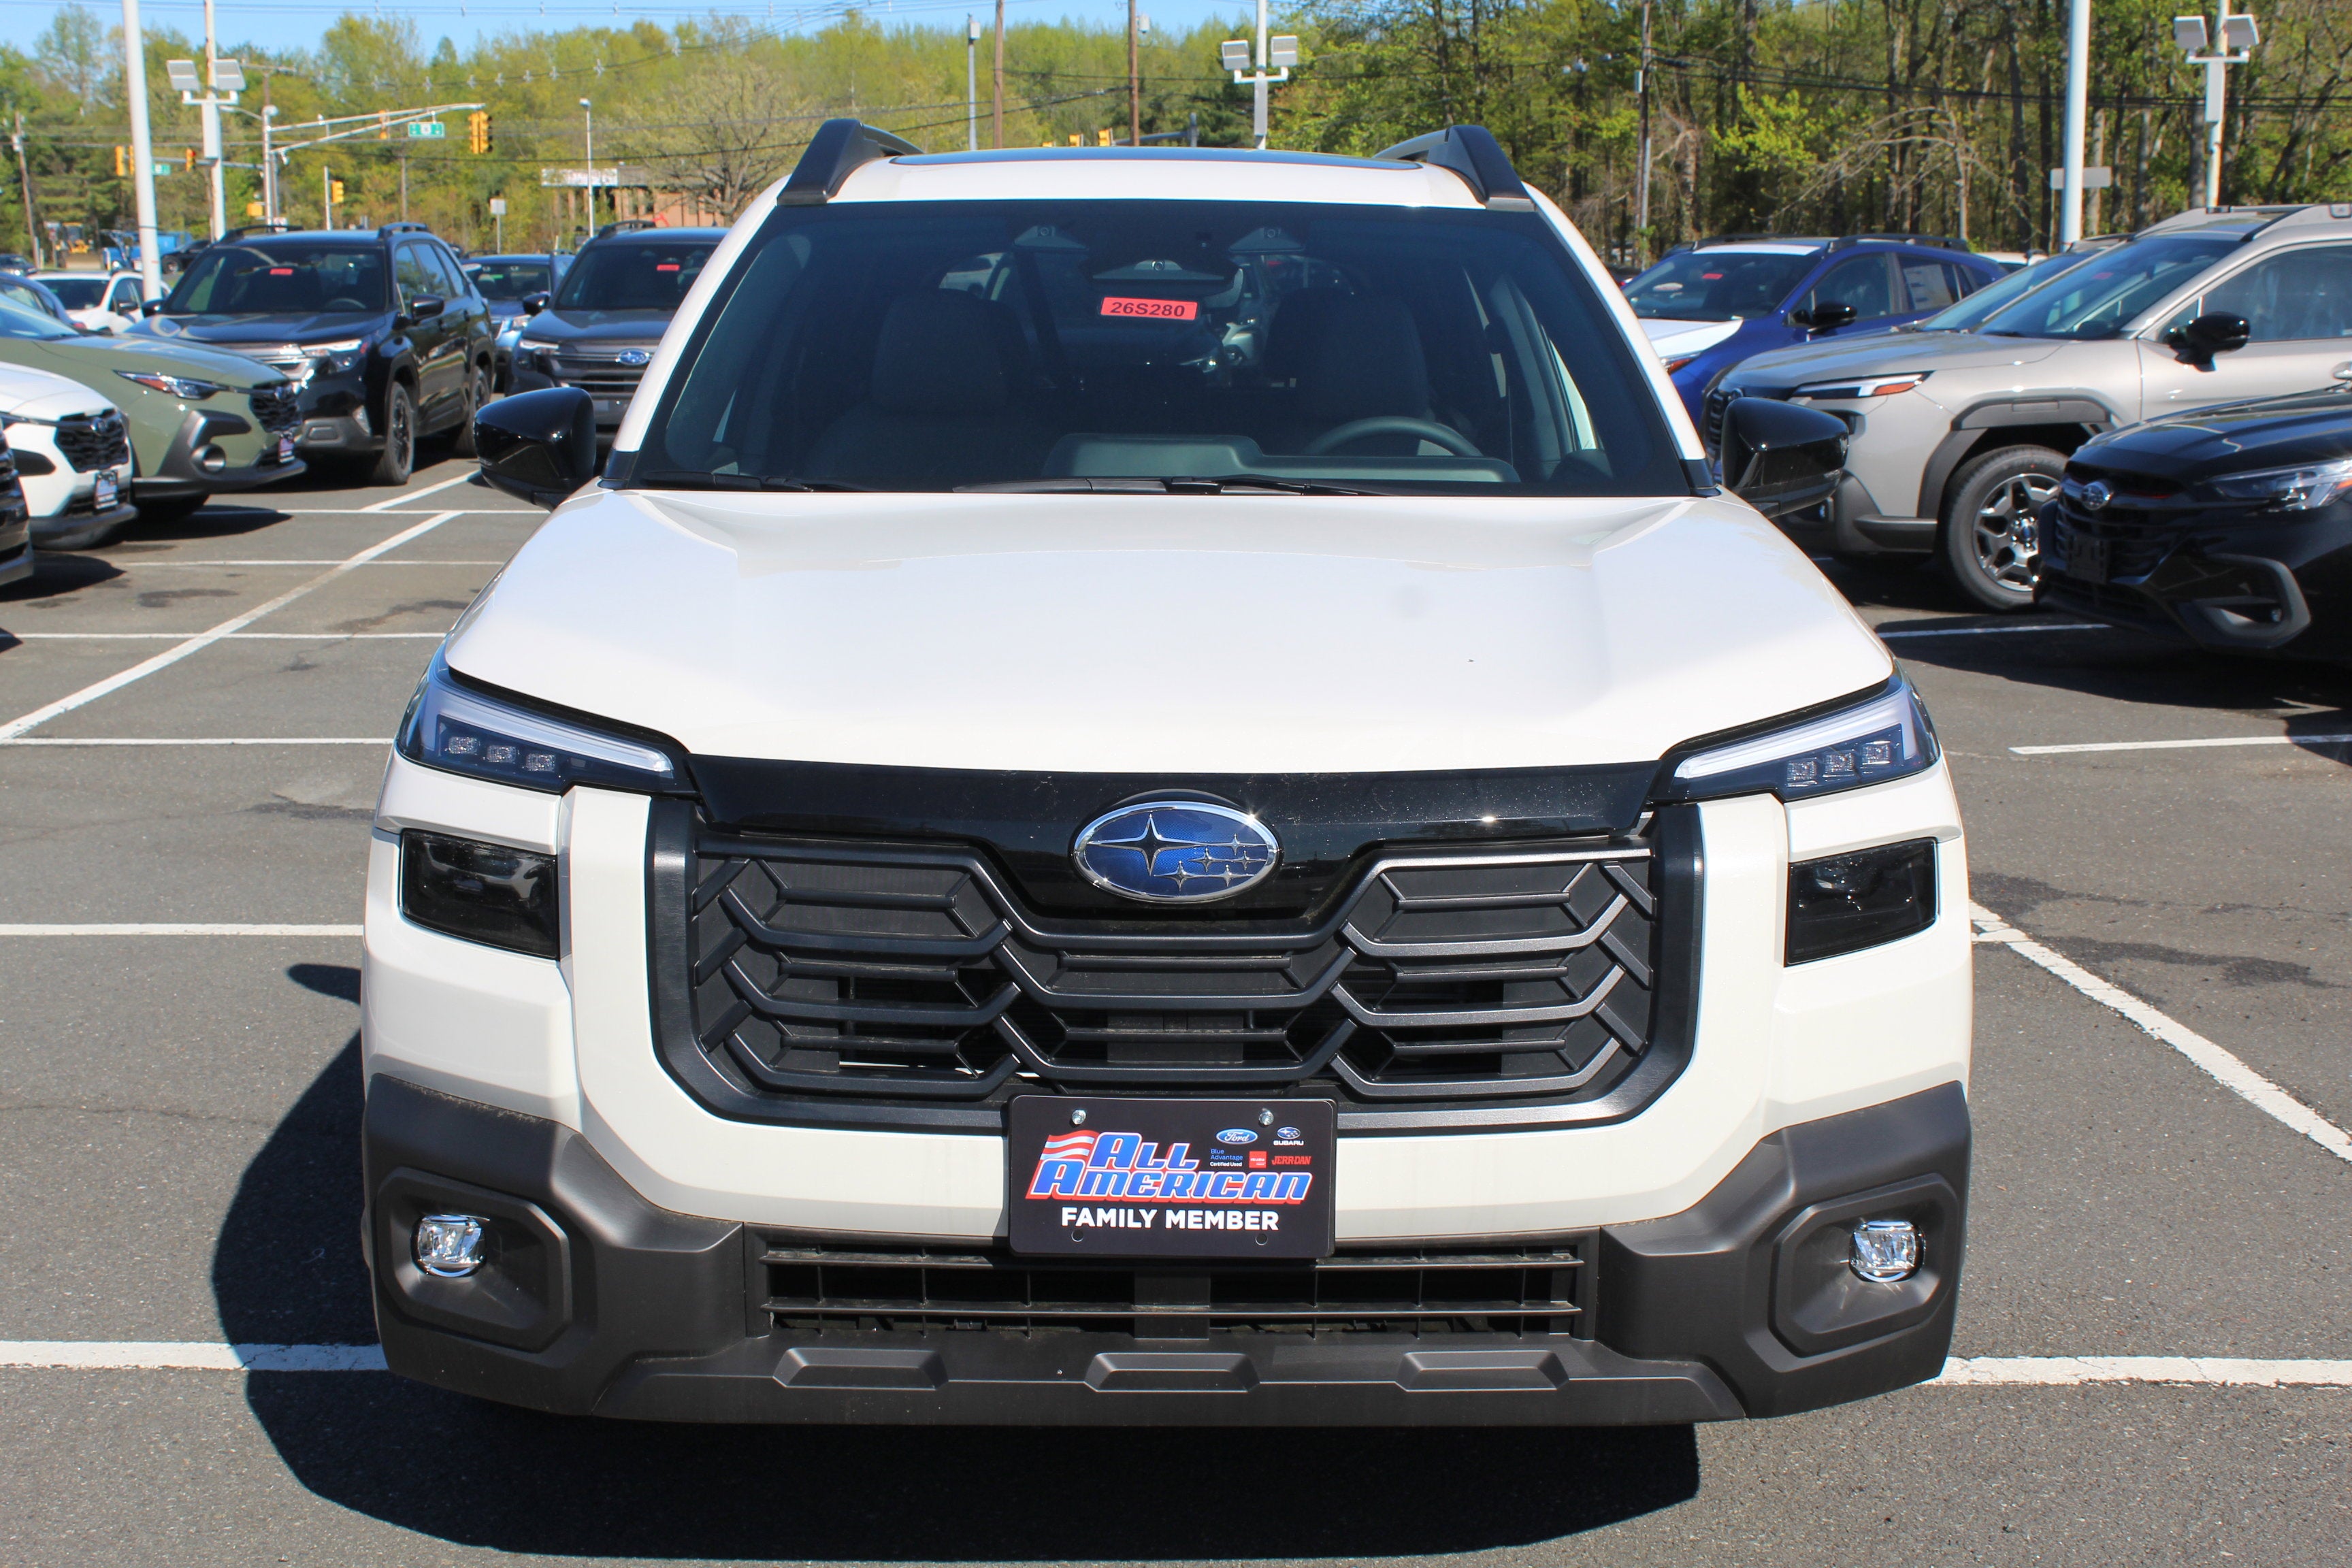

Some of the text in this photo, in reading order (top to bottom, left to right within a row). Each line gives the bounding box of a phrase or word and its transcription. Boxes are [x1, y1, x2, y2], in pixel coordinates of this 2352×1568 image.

[1110, 301, 1186, 317] 26S280
[1224, 1131, 1250, 1142] Ford
[1086, 1131, 1200, 1171] ALL
[1062, 1207, 1279, 1231] FAMILY MEMBER
